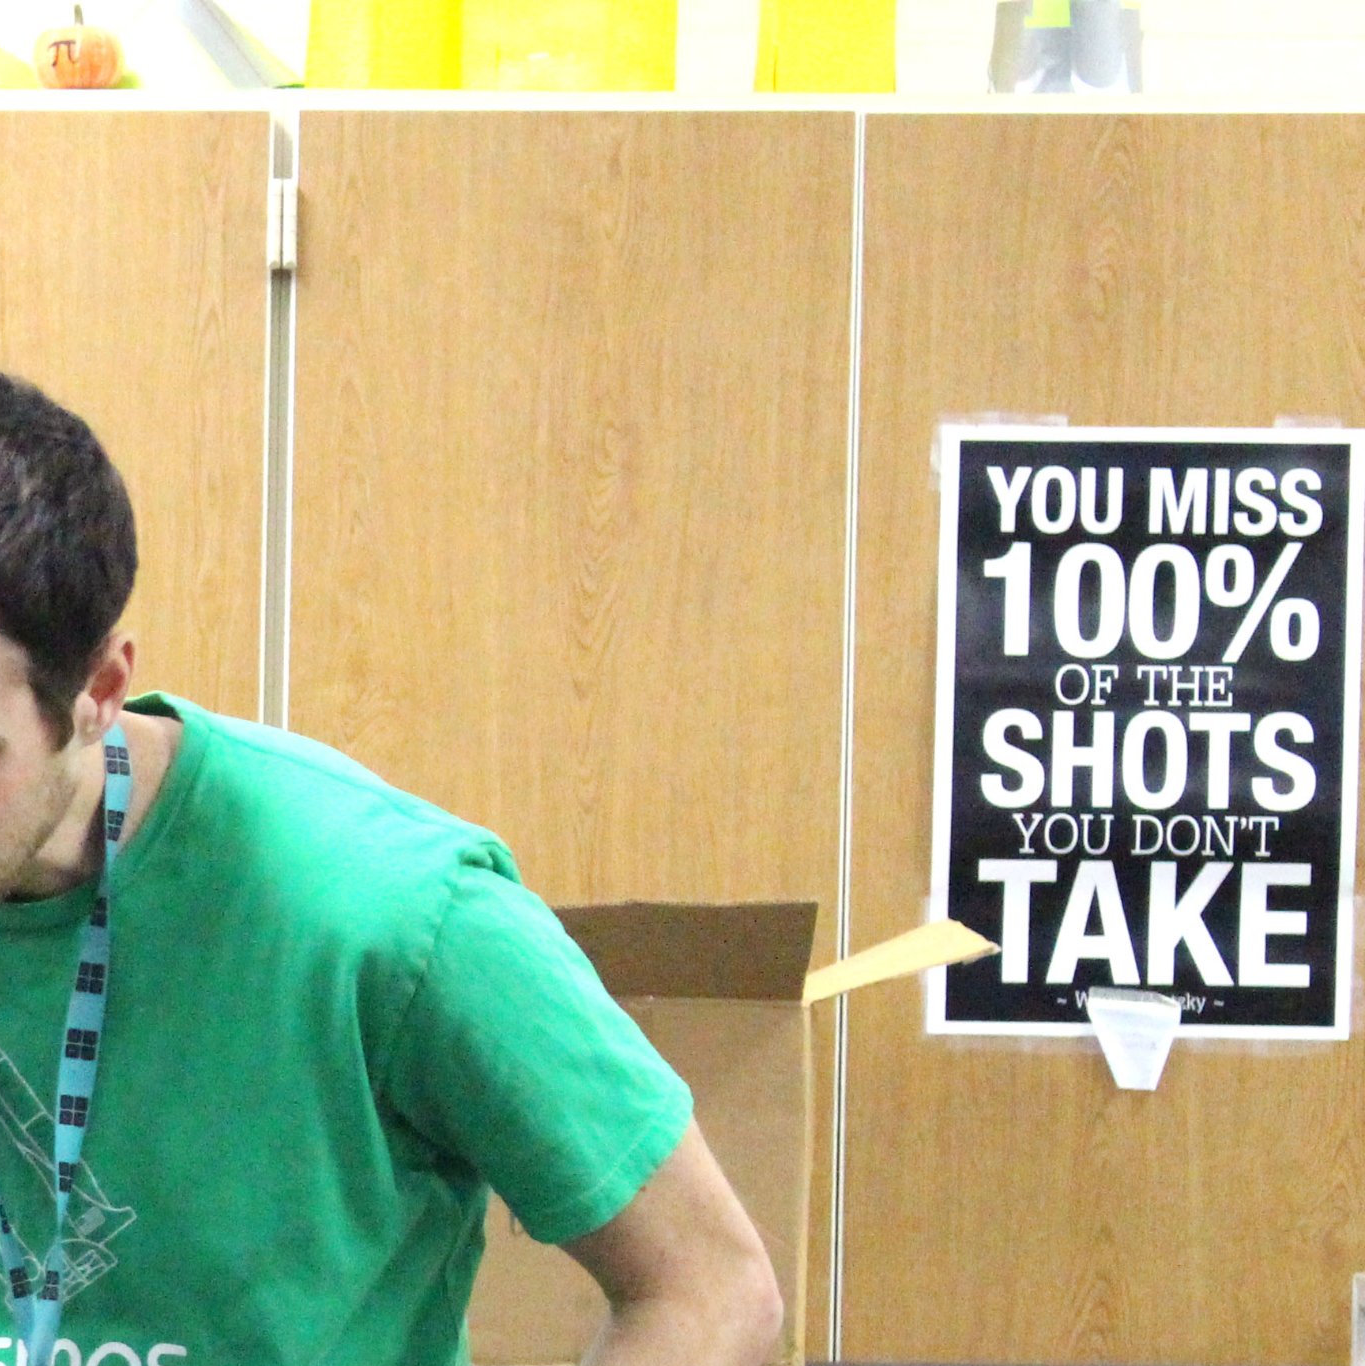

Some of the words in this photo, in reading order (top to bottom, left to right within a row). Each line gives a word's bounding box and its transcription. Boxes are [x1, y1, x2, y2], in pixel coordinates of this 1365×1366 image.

[986, 465, 1124, 534] YOU
[1148, 466, 1323, 537] MISS
[983, 541, 1320, 663] 100%
[1054, 665, 1119, 706] OF
[1137, 665, 1234, 707] THE
[980, 708, 1317, 812] SHOTS
[1012, 813, 1115, 855] YOU
[1131, 814, 1280, 857] DON'T
[978, 859, 1312, 988] TAKE
